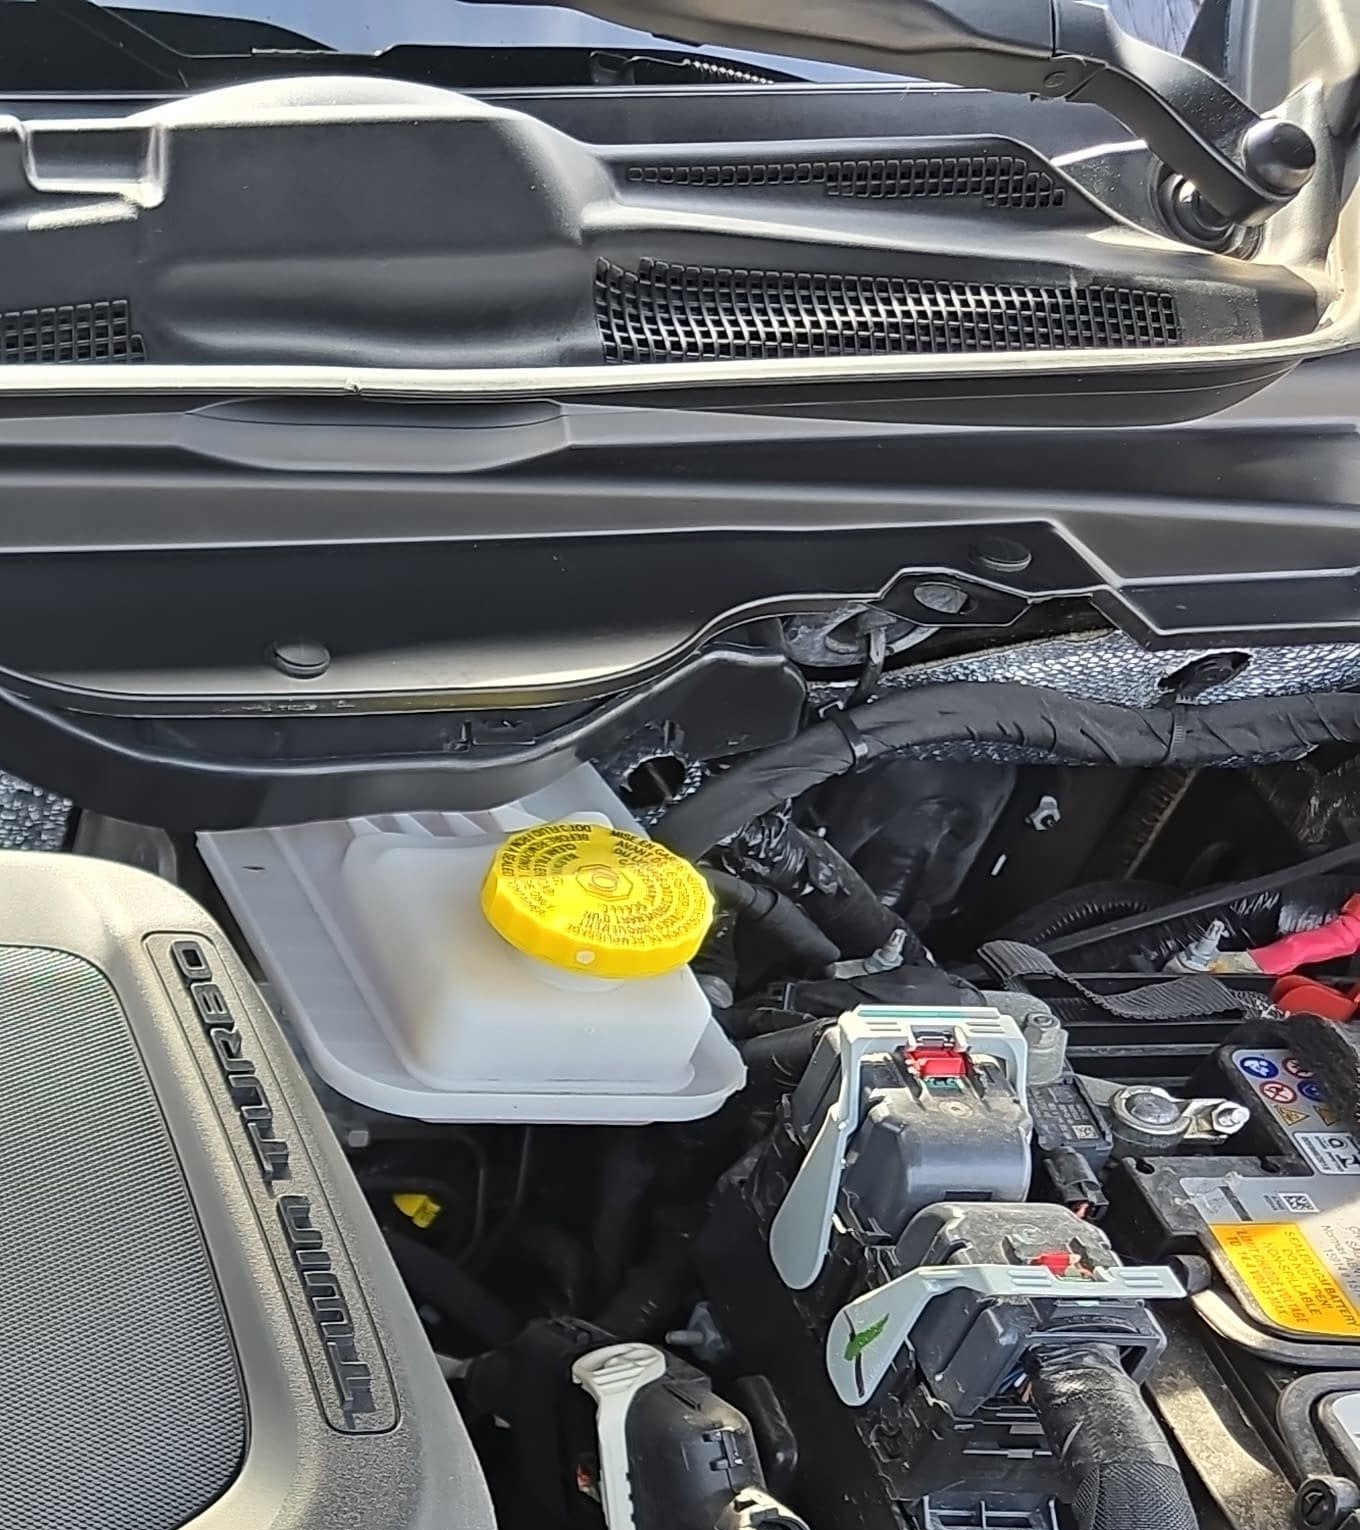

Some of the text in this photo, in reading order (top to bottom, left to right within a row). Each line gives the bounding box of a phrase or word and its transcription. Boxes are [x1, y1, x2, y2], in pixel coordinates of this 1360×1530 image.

[570, 824, 592, 832] DOT
[548, 834, 589, 845] BEFORE
[612, 830, 638, 842] MISE
[639, 840, 655, 849] EN
[616, 841, 653, 857] AVANT
[169, 939, 378, 1412] TWIN TURBO
